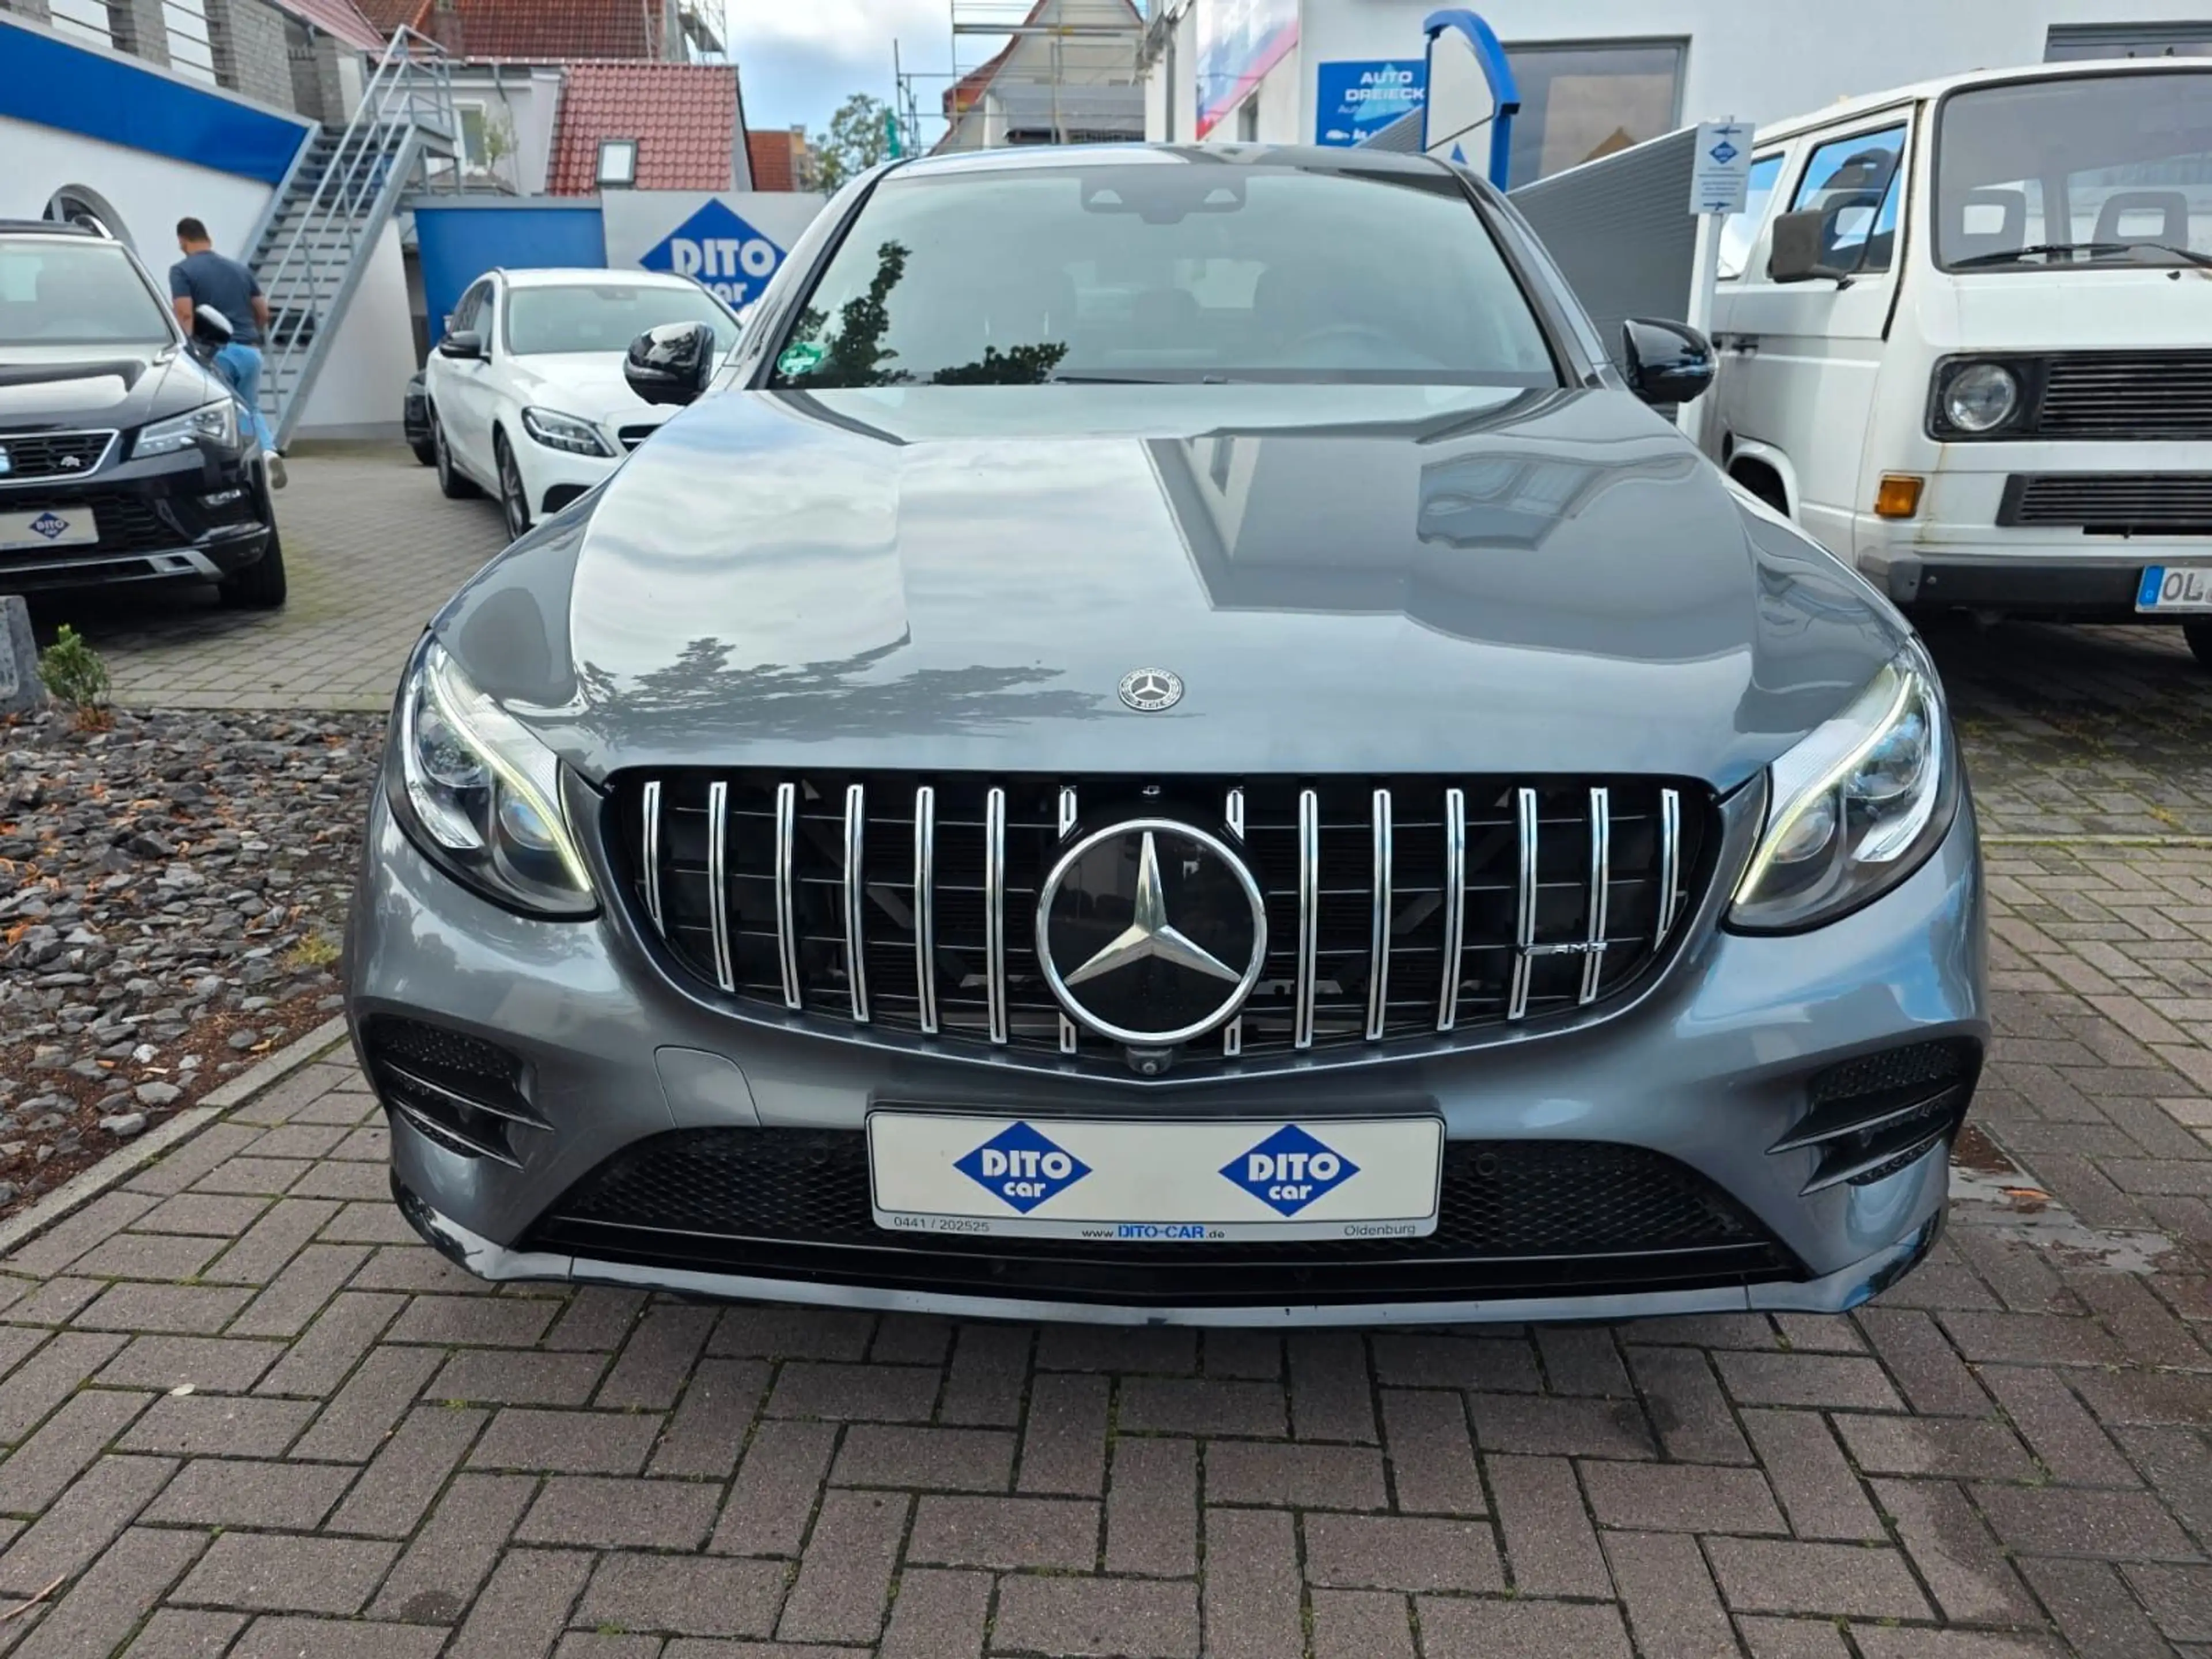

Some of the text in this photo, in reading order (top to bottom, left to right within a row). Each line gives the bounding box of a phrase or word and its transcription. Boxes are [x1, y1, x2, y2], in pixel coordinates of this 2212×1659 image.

[1360, 71, 1414, 85] AUTO
[1345, 88, 1425, 101] DREIECK
[671, 238, 777, 278] DITO
[702, 282, 747, 303] ar
[982, 1149, 1072, 1180] DITO
[1248, 1153, 1340, 1181] DITO
[1002, 1181, 1046, 1198] car
[1268, 1185, 1313, 1200] car
[894, 1217, 926, 1228] 0441
[1344, 1224, 1415, 1236] Oldenburg
